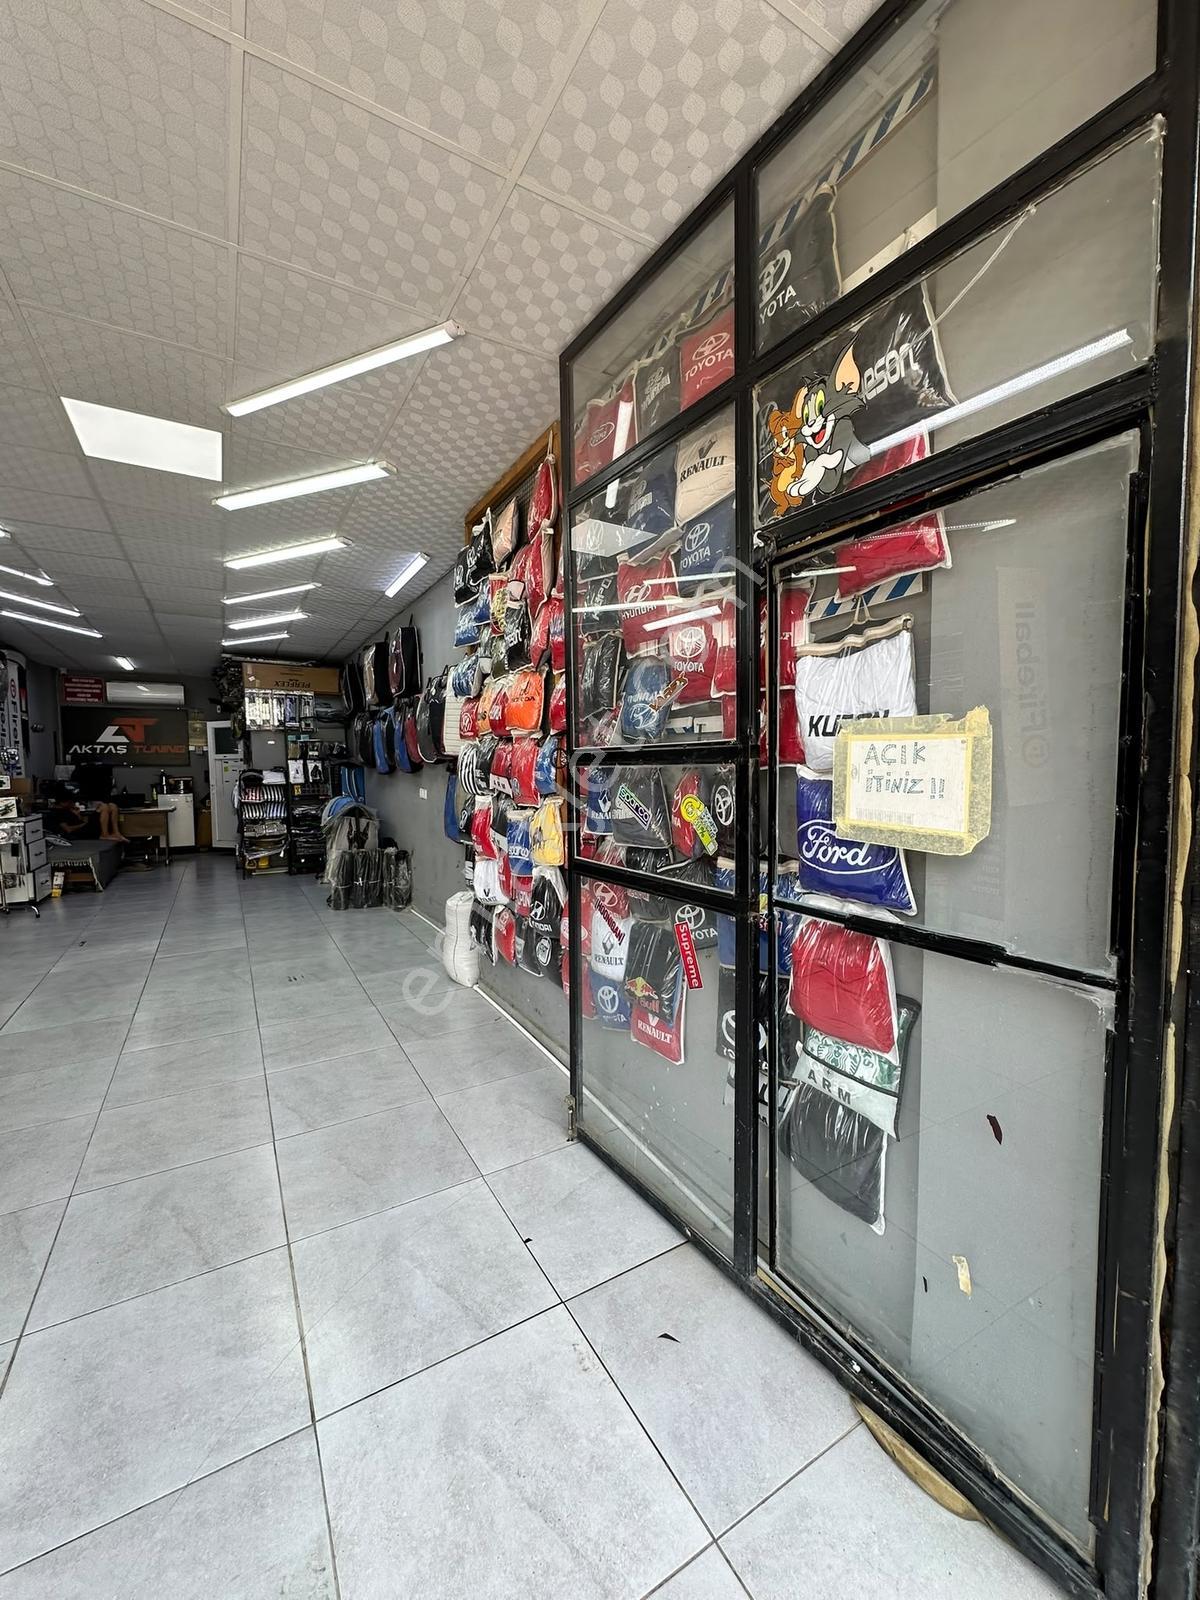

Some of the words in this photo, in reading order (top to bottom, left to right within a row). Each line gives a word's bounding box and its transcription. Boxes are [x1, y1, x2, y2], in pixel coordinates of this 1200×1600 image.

[759, 285, 797, 325] YOTA
[684, 348, 734, 382] TOYOTA
[680, 455, 727, 483] RENAULT
[680, 545, 711, 569] TOYOTA
[673, 661, 704, 673] TOYOTA
[134, 745, 186, 754] TUNING
[619, 787, 651, 823] sparco
[802, 827, 872, 867] Ford
[594, 954, 624, 966] RENAULT
[679, 924, 699, 987] Supreme
[637, 1020, 672, 1044] RENAULT
